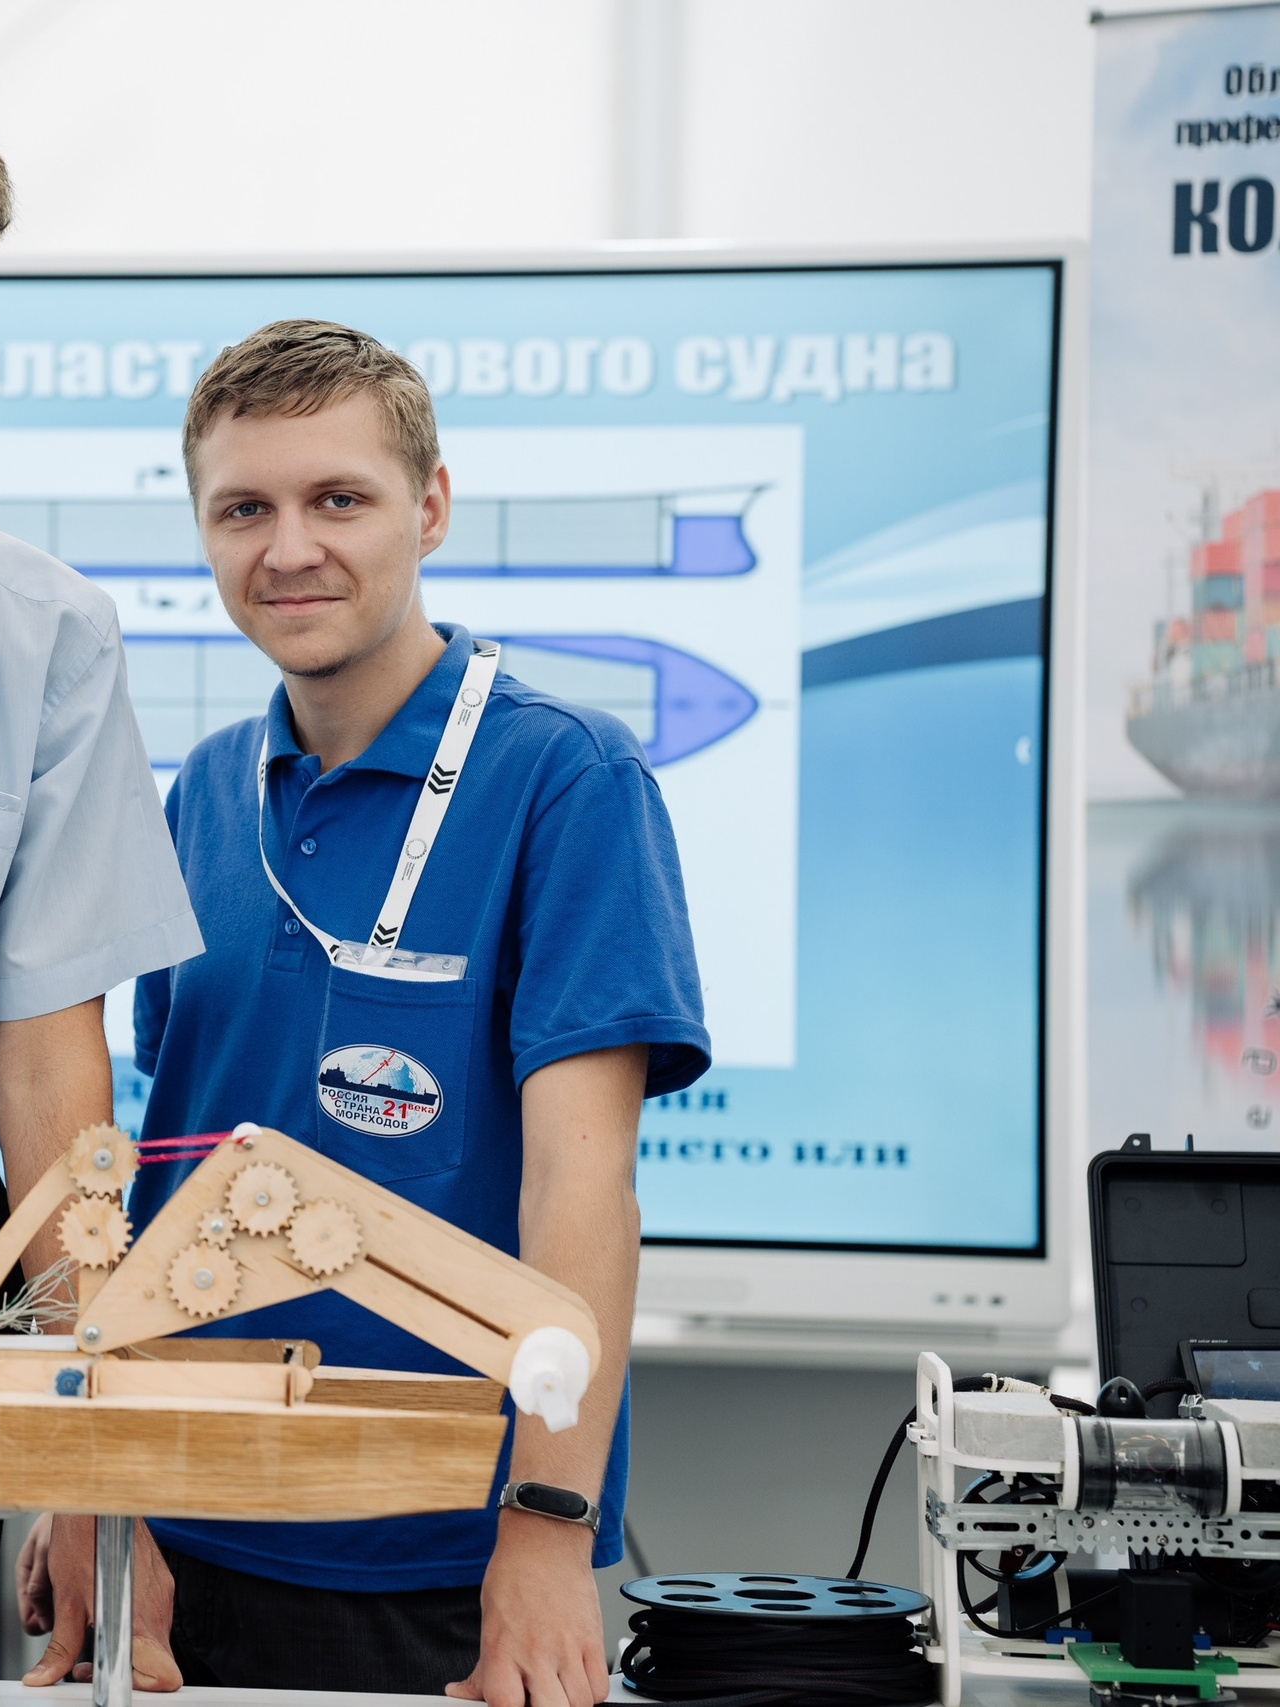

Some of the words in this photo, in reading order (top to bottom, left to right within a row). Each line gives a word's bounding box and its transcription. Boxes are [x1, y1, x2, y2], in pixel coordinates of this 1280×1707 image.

[1173, 176, 1280, 256] КО
[674, 330, 955, 402] судна
[321, 1087, 368, 1104] РОССИЯ
[334, 1099, 380, 1115] СТРАНА
[382, 1099, 407, 1119] 21
[407, 1103, 435, 1114] века
[335, 1108, 409, 1130] МОРЕХОДОВ
